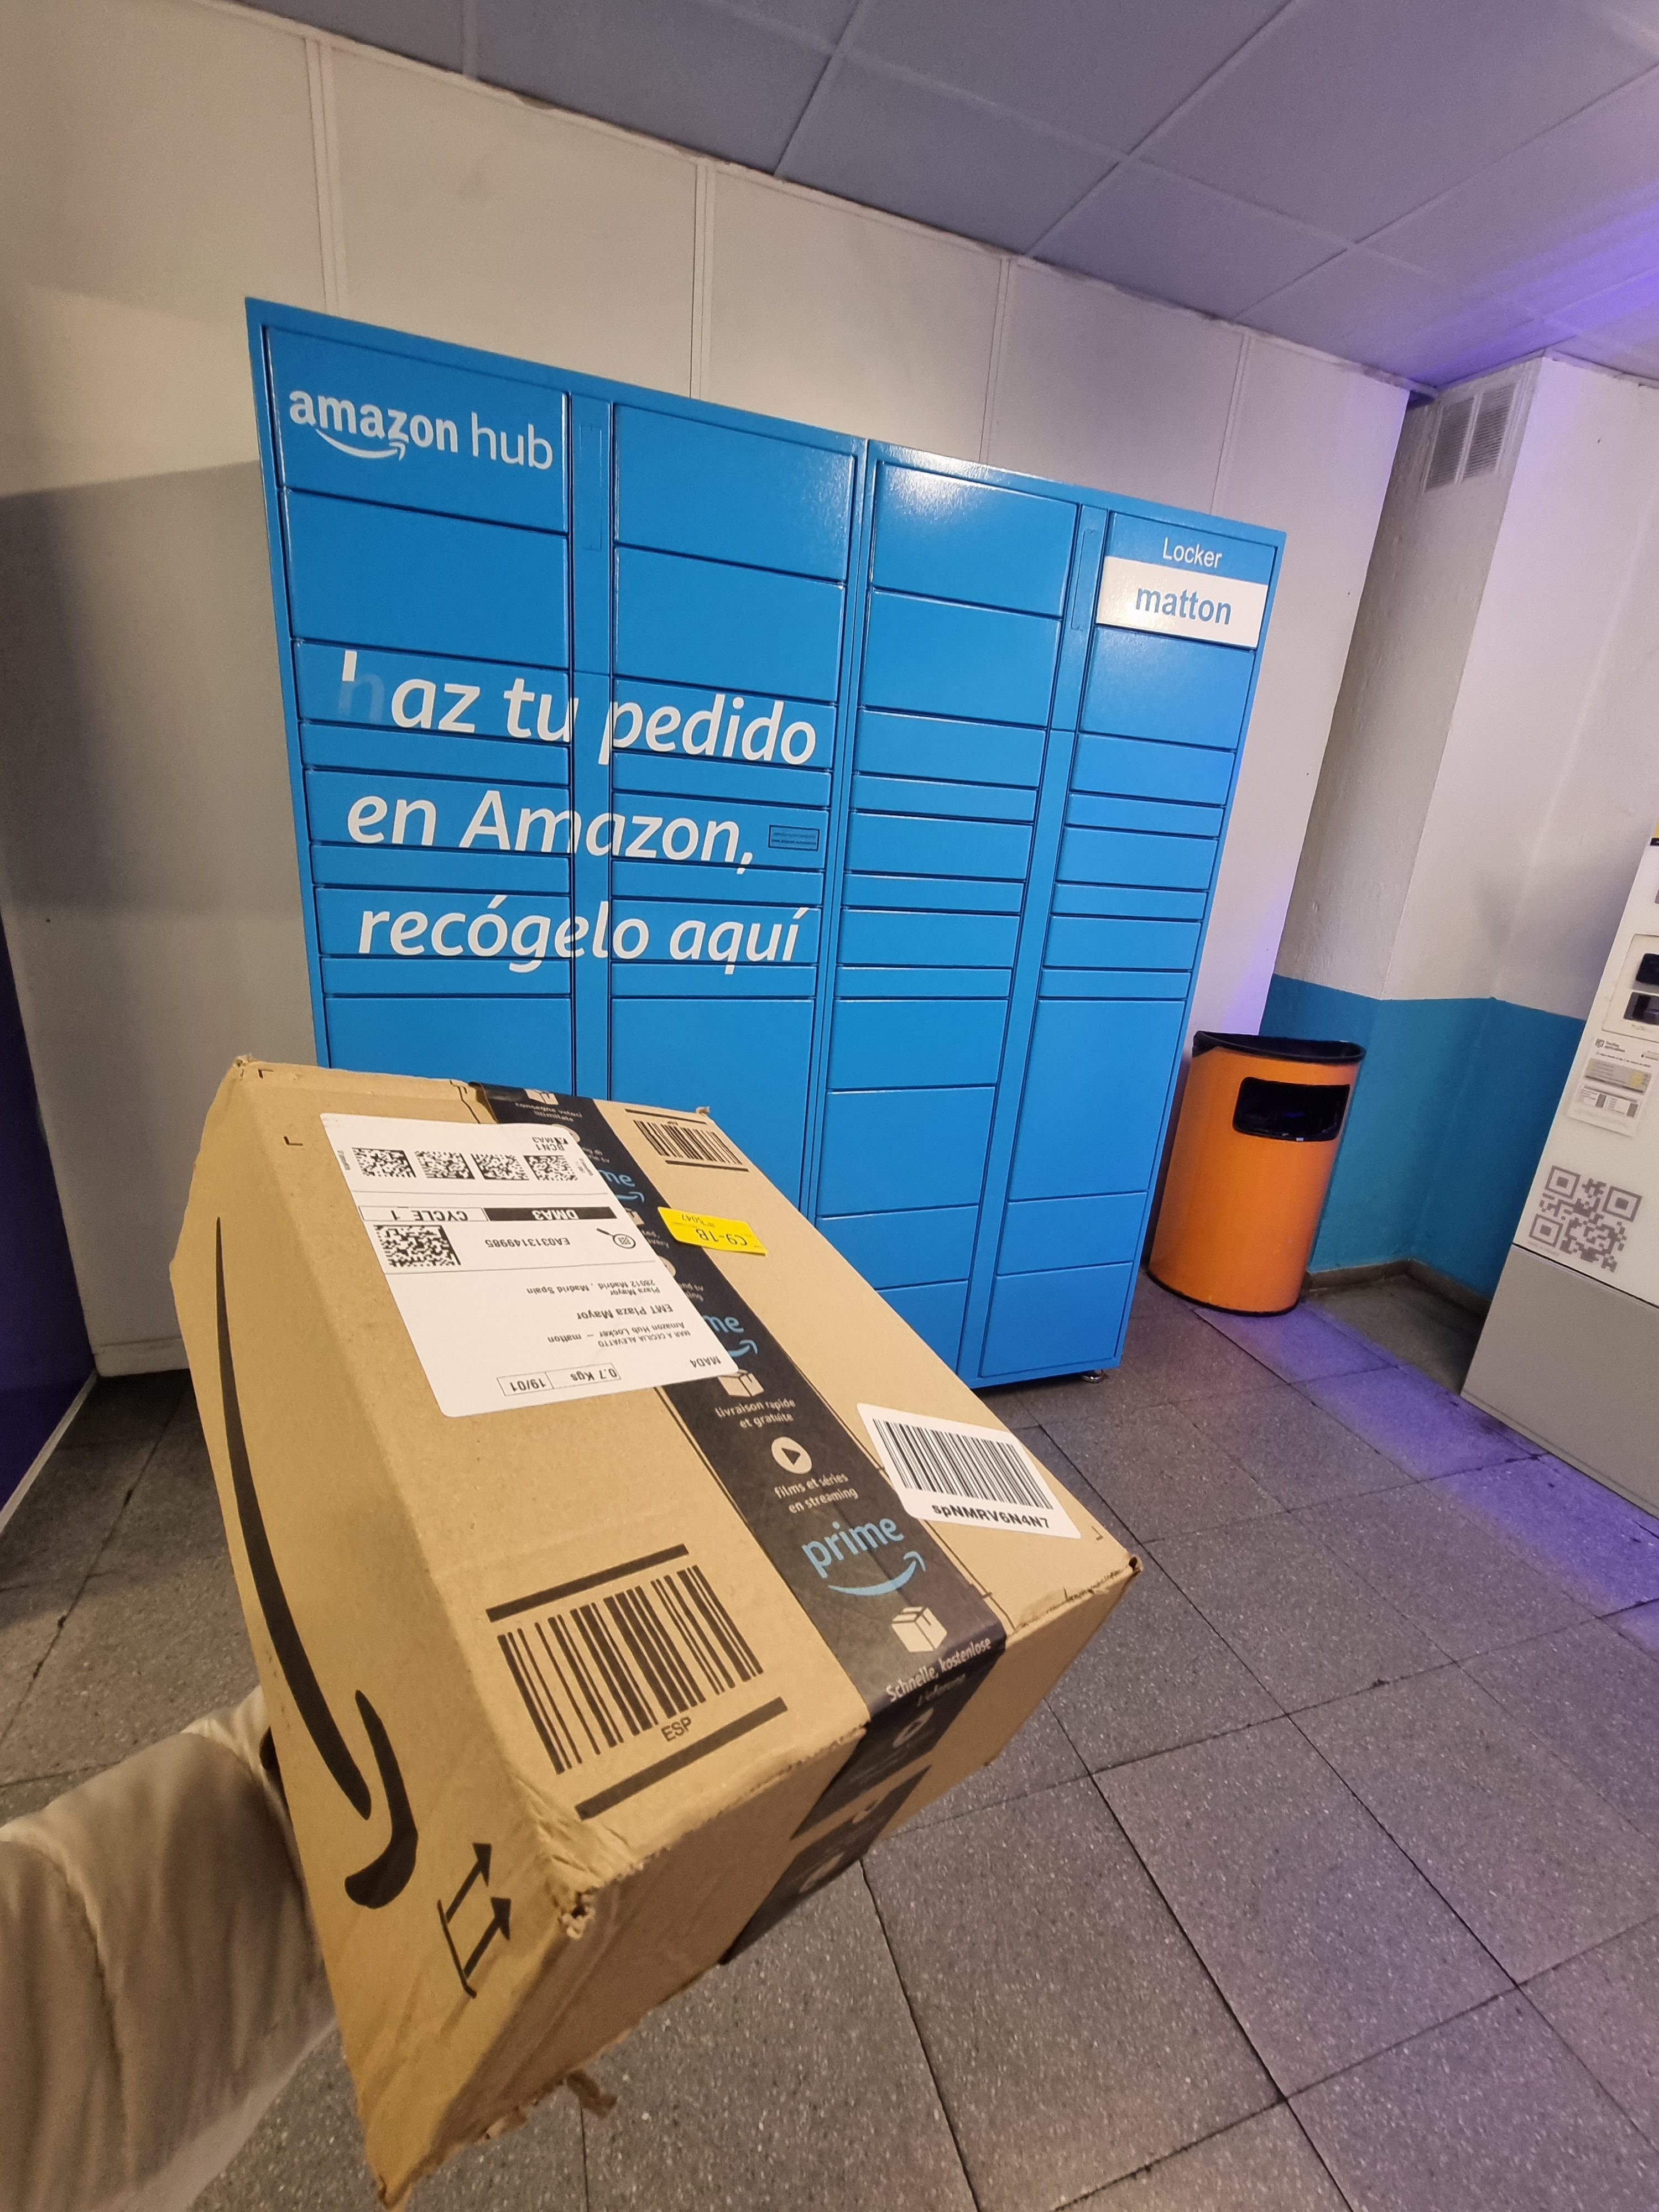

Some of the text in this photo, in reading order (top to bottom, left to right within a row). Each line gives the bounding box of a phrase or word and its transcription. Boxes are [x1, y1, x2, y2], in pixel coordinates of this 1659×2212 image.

[289, 390, 553, 470] amazon hub
[1162, 536, 1222, 568] Locker
[1135, 587, 1232, 625] matton
[503, 677, 580, 743] tu
[598, 693, 816, 766] pedido
[347, 790, 753, 875] en Amazon,
[358, 895, 809, 975] recógelo aquí
[390, 1209, 579, 1222] DMA3 CYCLE 1
[484, 1237, 571, 1248] EA0313149985
[696, 1229, 748, 1246] C9-1B
[526, 1286, 555, 1295] Spain
[556, 1284, 590, 1293] Madrid
[598, 1280, 628, 1290] Madrid
[630, 1279, 656, 1288] 28012
[576, 1303, 674, 1319] EMT Plaza Mayor
[599, 1328, 630, 1338] Locker
[632, 1325, 651, 1334] Hub
[651, 1321, 685, 1330] Amazon
[547, 1333, 582, 1343] matton
[597, 1336, 637, 1348] ALEVATTO
[639, 1333, 666, 1342] CECILIA
[689, 1355, 722, 1369] MAD4
[509, 1368, 617, 1393] 0.7 Kgs 19/01
[715, 1397, 796, 1418] livraison rapide
[739, 1412, 794, 1429] et gratuite
[774, 1472, 849, 1500] films et séries
[788, 1487, 859, 1514] en streaming
[931, 1504, 1050, 1529] spNMRV6N4N7
[801, 1517, 905, 1579] prime
[885, 1665, 940, 1703] Schnelle,
[938, 1636, 992, 1674] kostenlose
[660, 1717, 692, 1743] ESP
